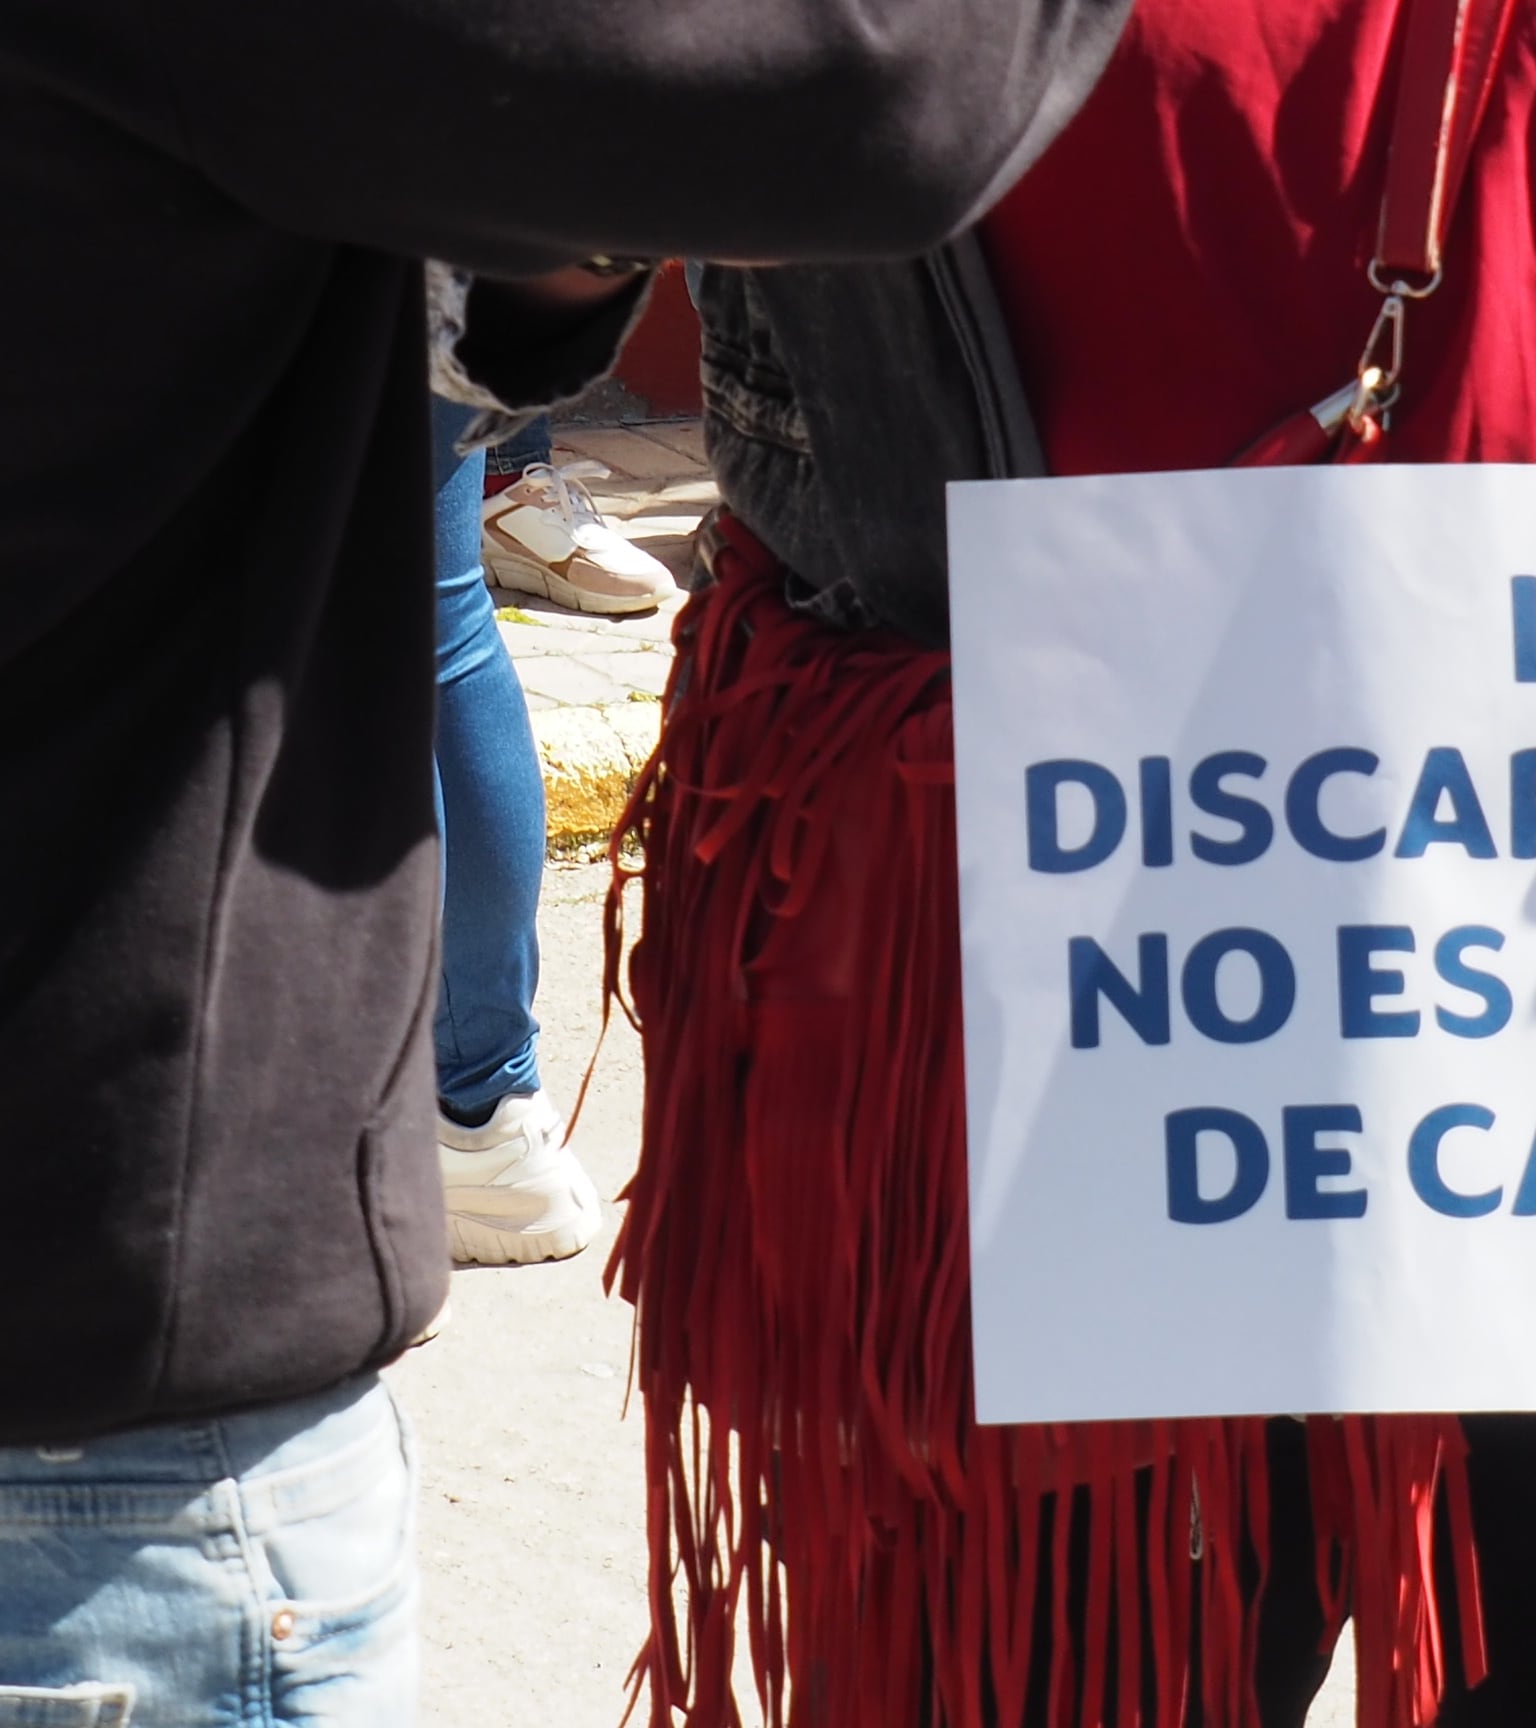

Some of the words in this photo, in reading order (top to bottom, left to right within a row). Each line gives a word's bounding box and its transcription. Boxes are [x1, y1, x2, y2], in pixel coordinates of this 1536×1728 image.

[1068, 927, 1298, 1050] NO
[1336, 925, 1514, 1041] ES
[1164, 1105, 1368, 1225] DE
